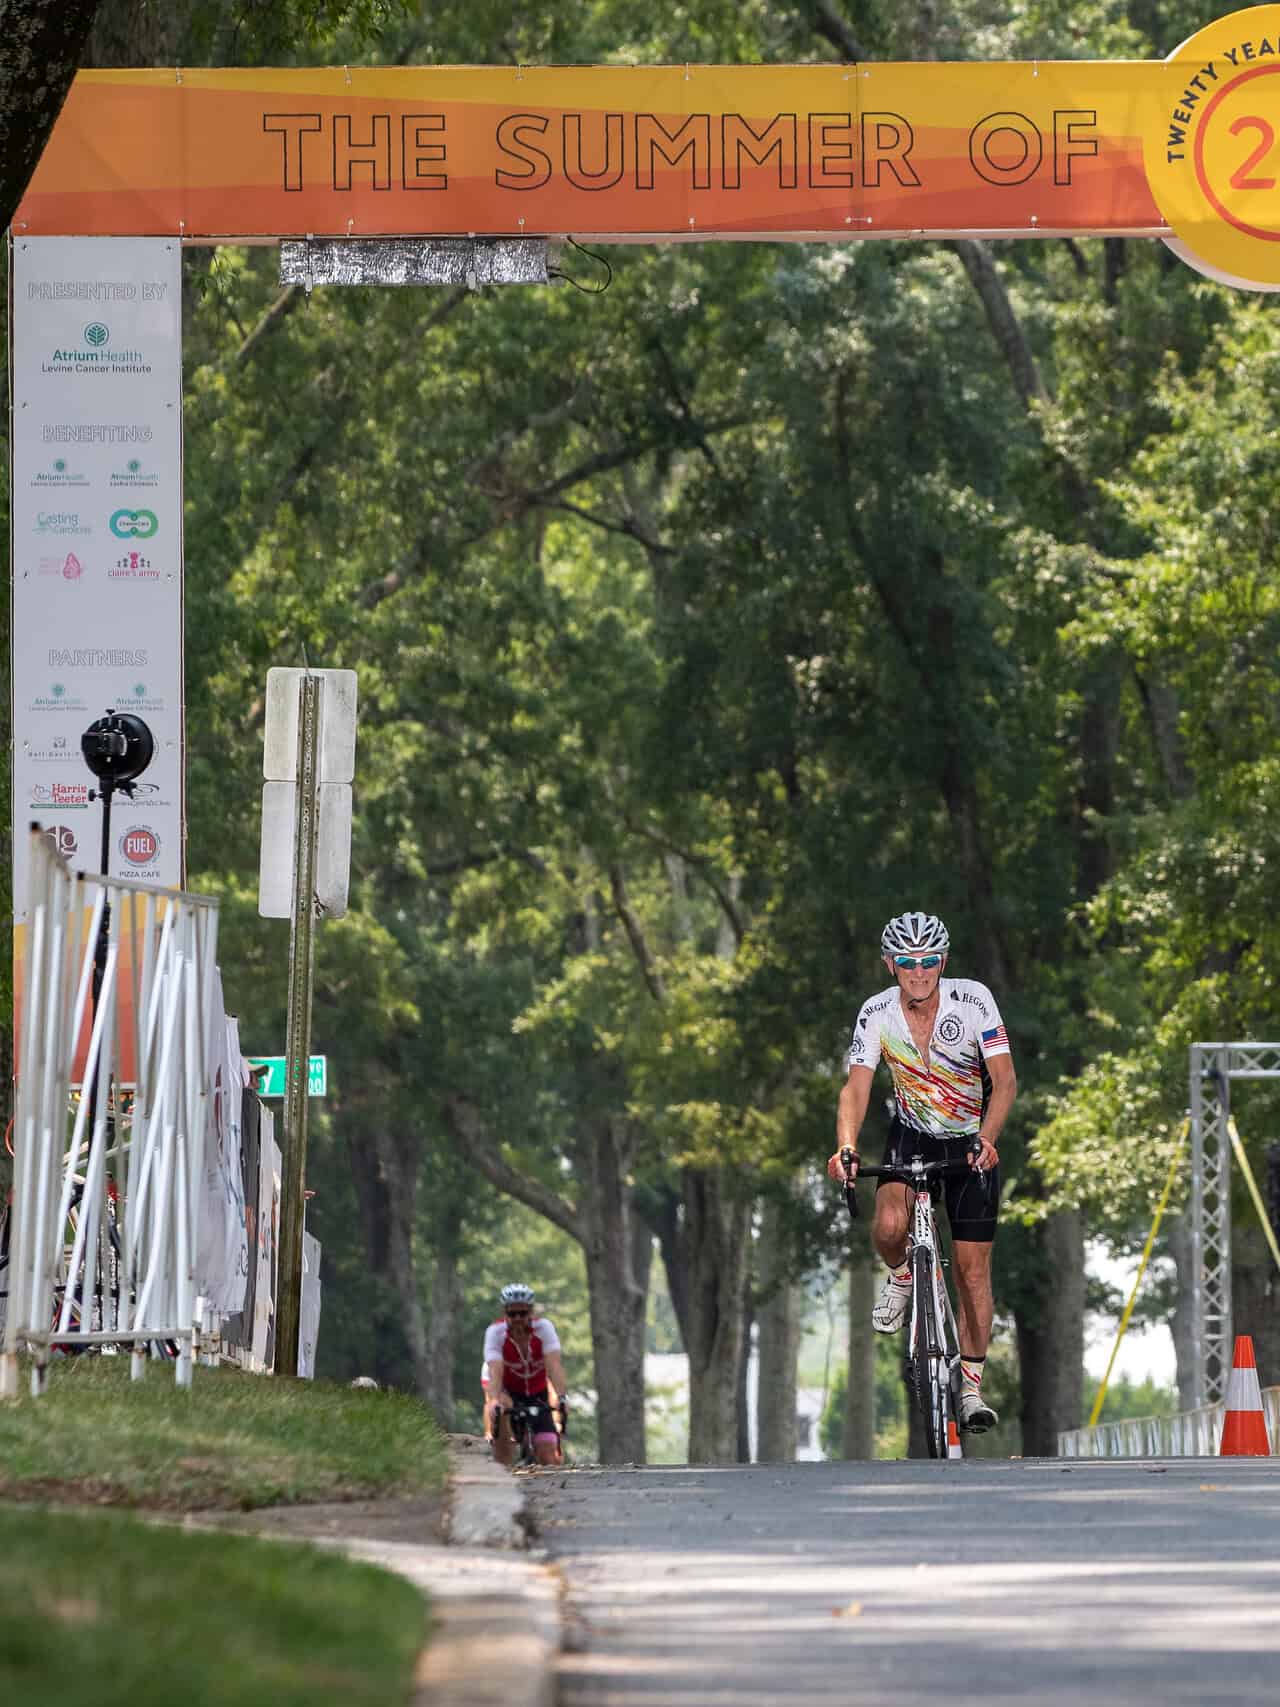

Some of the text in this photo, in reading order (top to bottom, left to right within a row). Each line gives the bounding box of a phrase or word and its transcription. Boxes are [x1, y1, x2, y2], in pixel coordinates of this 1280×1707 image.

[1167, 62, 1219, 163] TWENTY
[263, 113, 448, 192] THE
[495, 111, 921, 192] SUMMER
[968, 110, 1099, 187] OF
[27, 281, 168, 301] PRESENTED BY
[52, 349, 142, 361] Atrium Health
[41, 364, 151, 374] Levine Cancer Institute
[48, 649, 148, 666] PARTNERS
[52, 783, 87, 793] Harris
[53, 793, 87, 803] Teeter
[127, 837, 153, 853] FUEL
